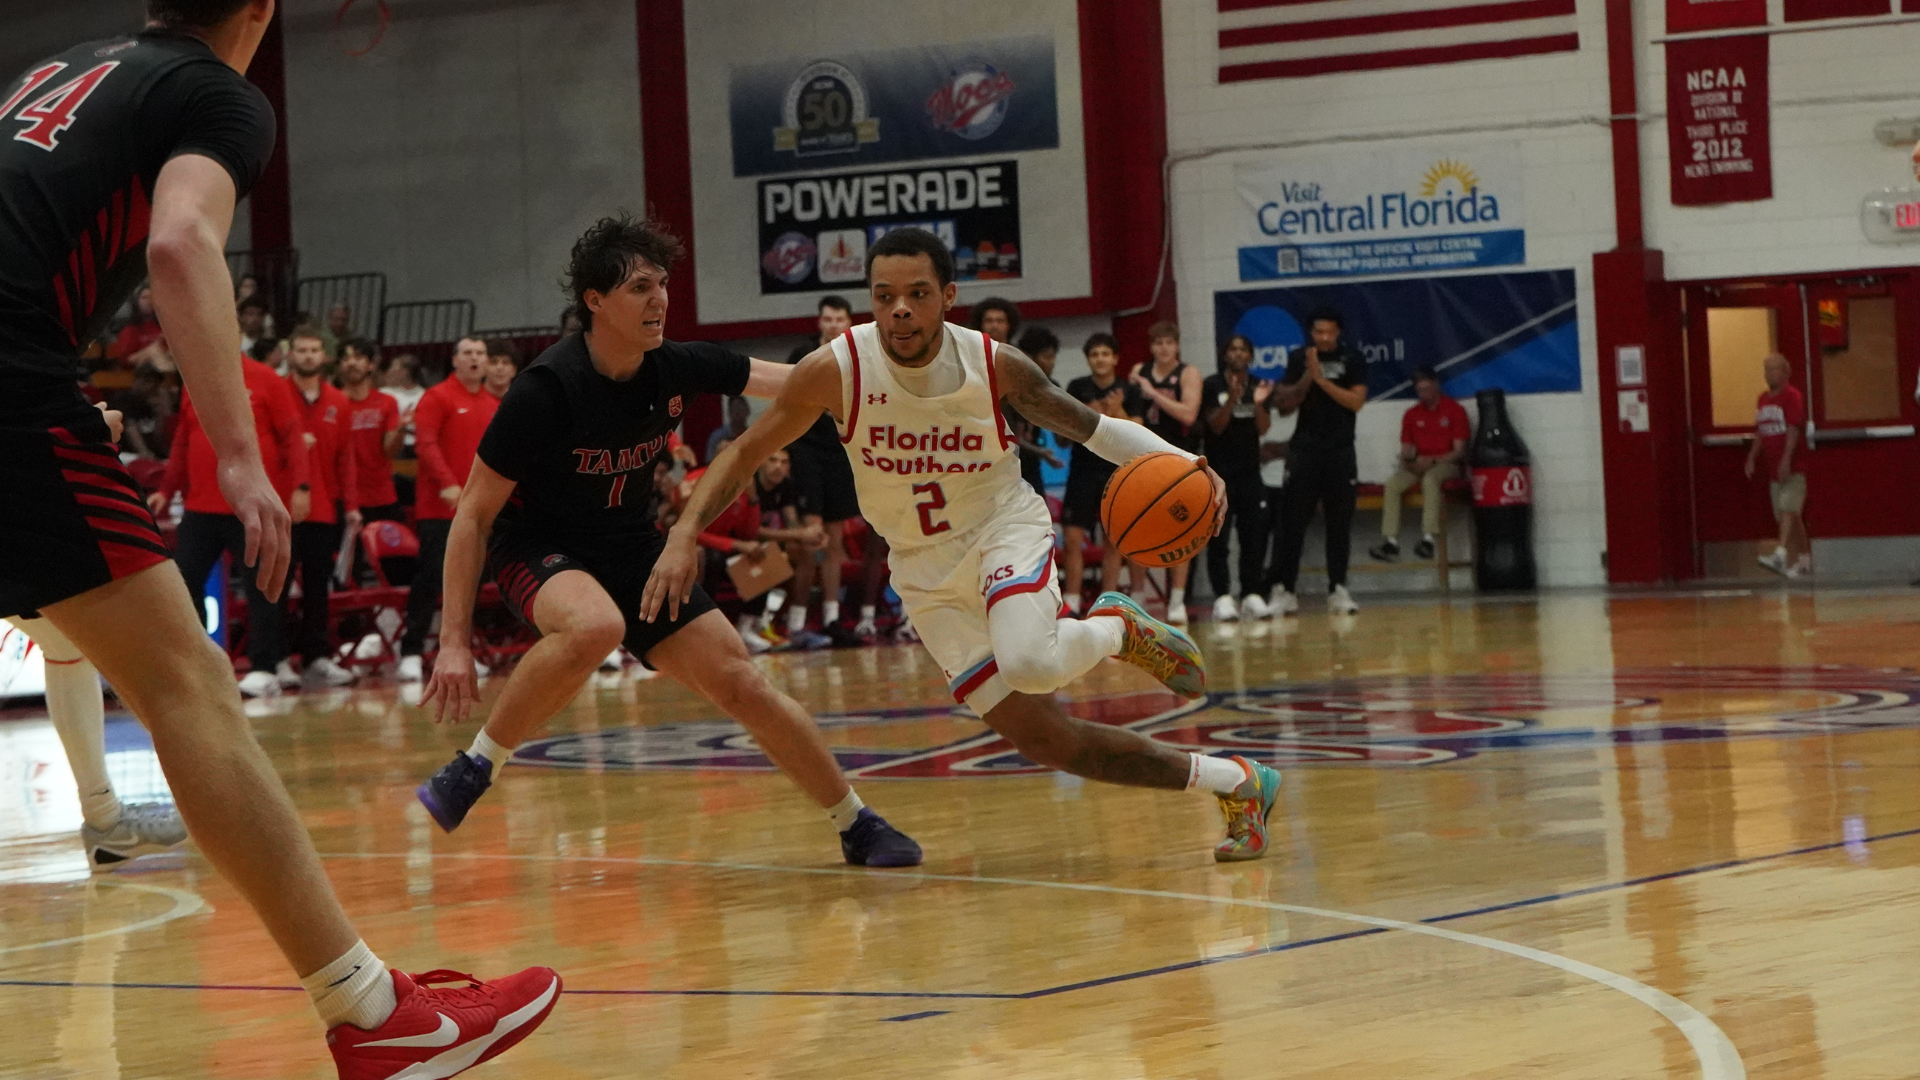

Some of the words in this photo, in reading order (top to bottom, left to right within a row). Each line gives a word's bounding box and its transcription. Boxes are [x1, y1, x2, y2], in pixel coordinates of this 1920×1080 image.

[1686, 67, 1746, 92] NCAA
[0, 60, 121, 152] 14
[802, 91, 847, 130] 50
[1691, 137, 1744, 161] 2012
[764, 166, 1003, 225] POWERADE
[1257, 195, 1375, 236] Central
[1382, 186, 1500, 229] Florida
[1281, 182, 1323, 204] Visit
[869, 425, 985, 452] Florida
[603, 474, 627, 509] 1
[912, 482, 952, 537] 2
